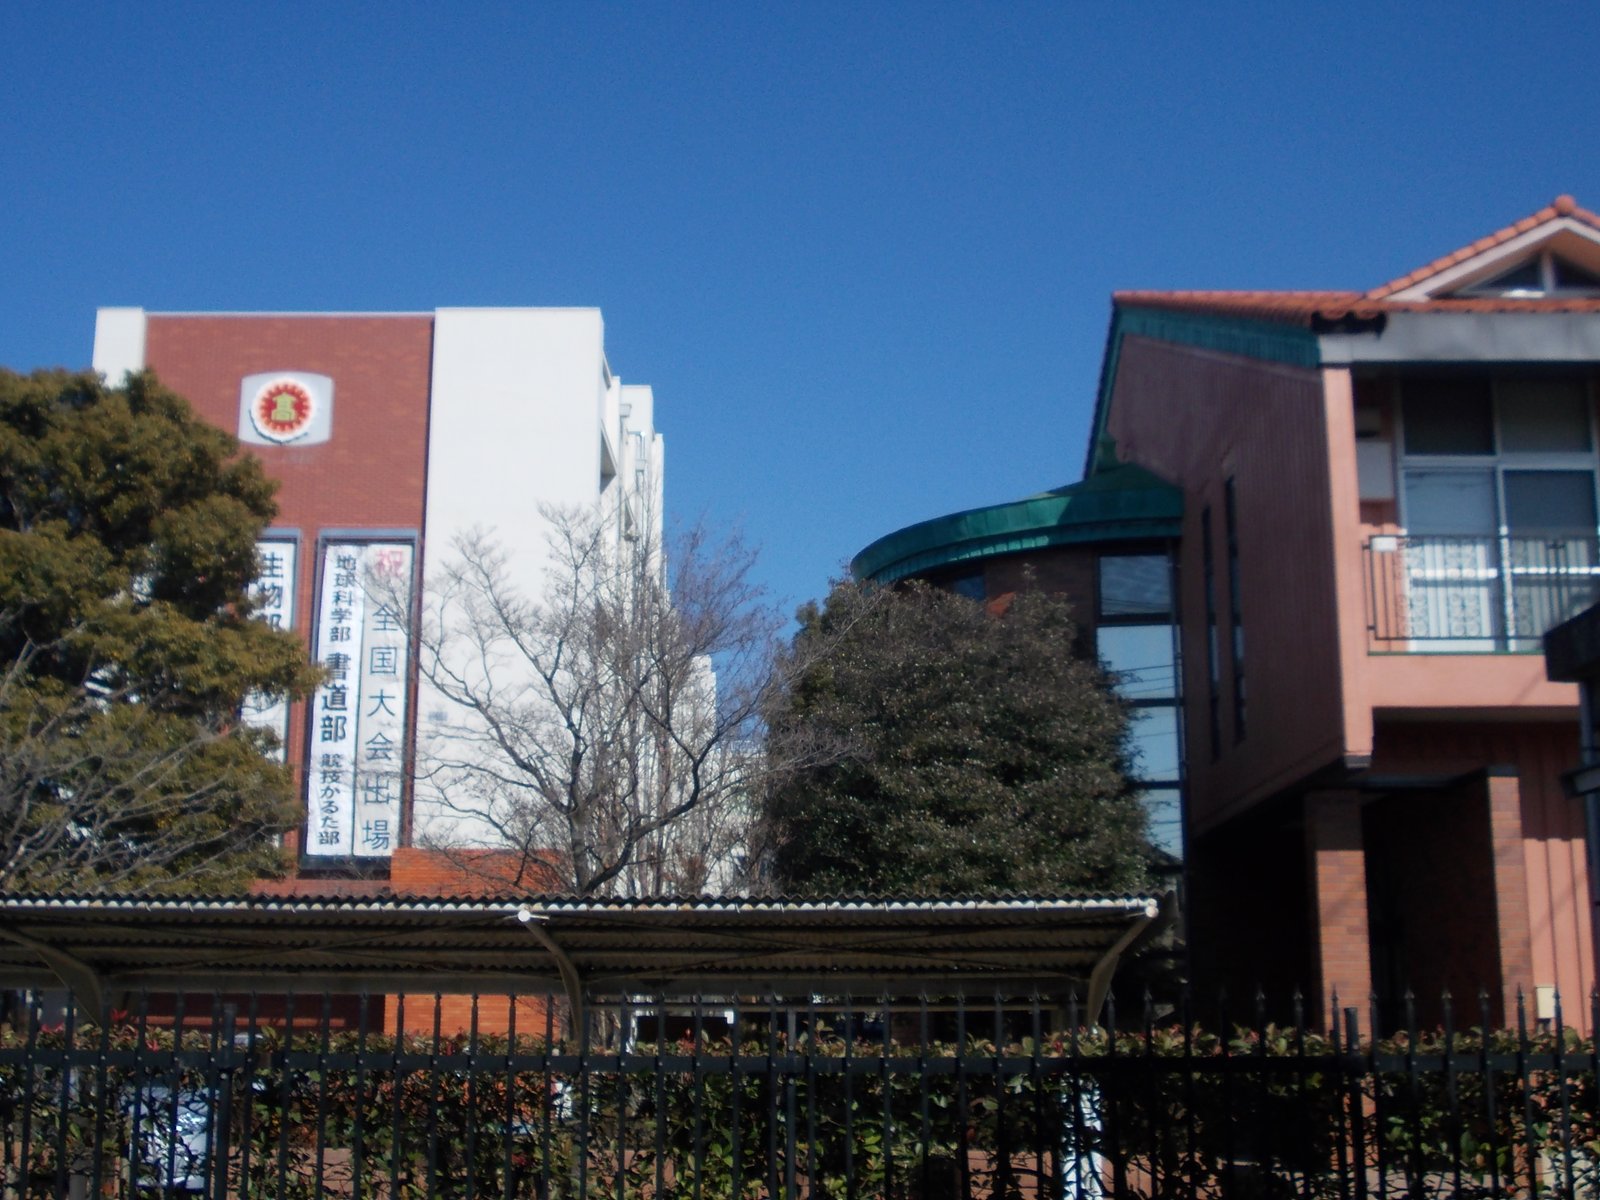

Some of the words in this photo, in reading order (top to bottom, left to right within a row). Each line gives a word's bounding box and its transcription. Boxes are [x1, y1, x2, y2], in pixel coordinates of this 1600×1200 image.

[328, 554, 357, 642] 地球科学部
[320, 652, 352, 743] 書道部
[362, 603, 399, 850] 全国大会出場
[318, 753, 344, 846] 競技かるた部
